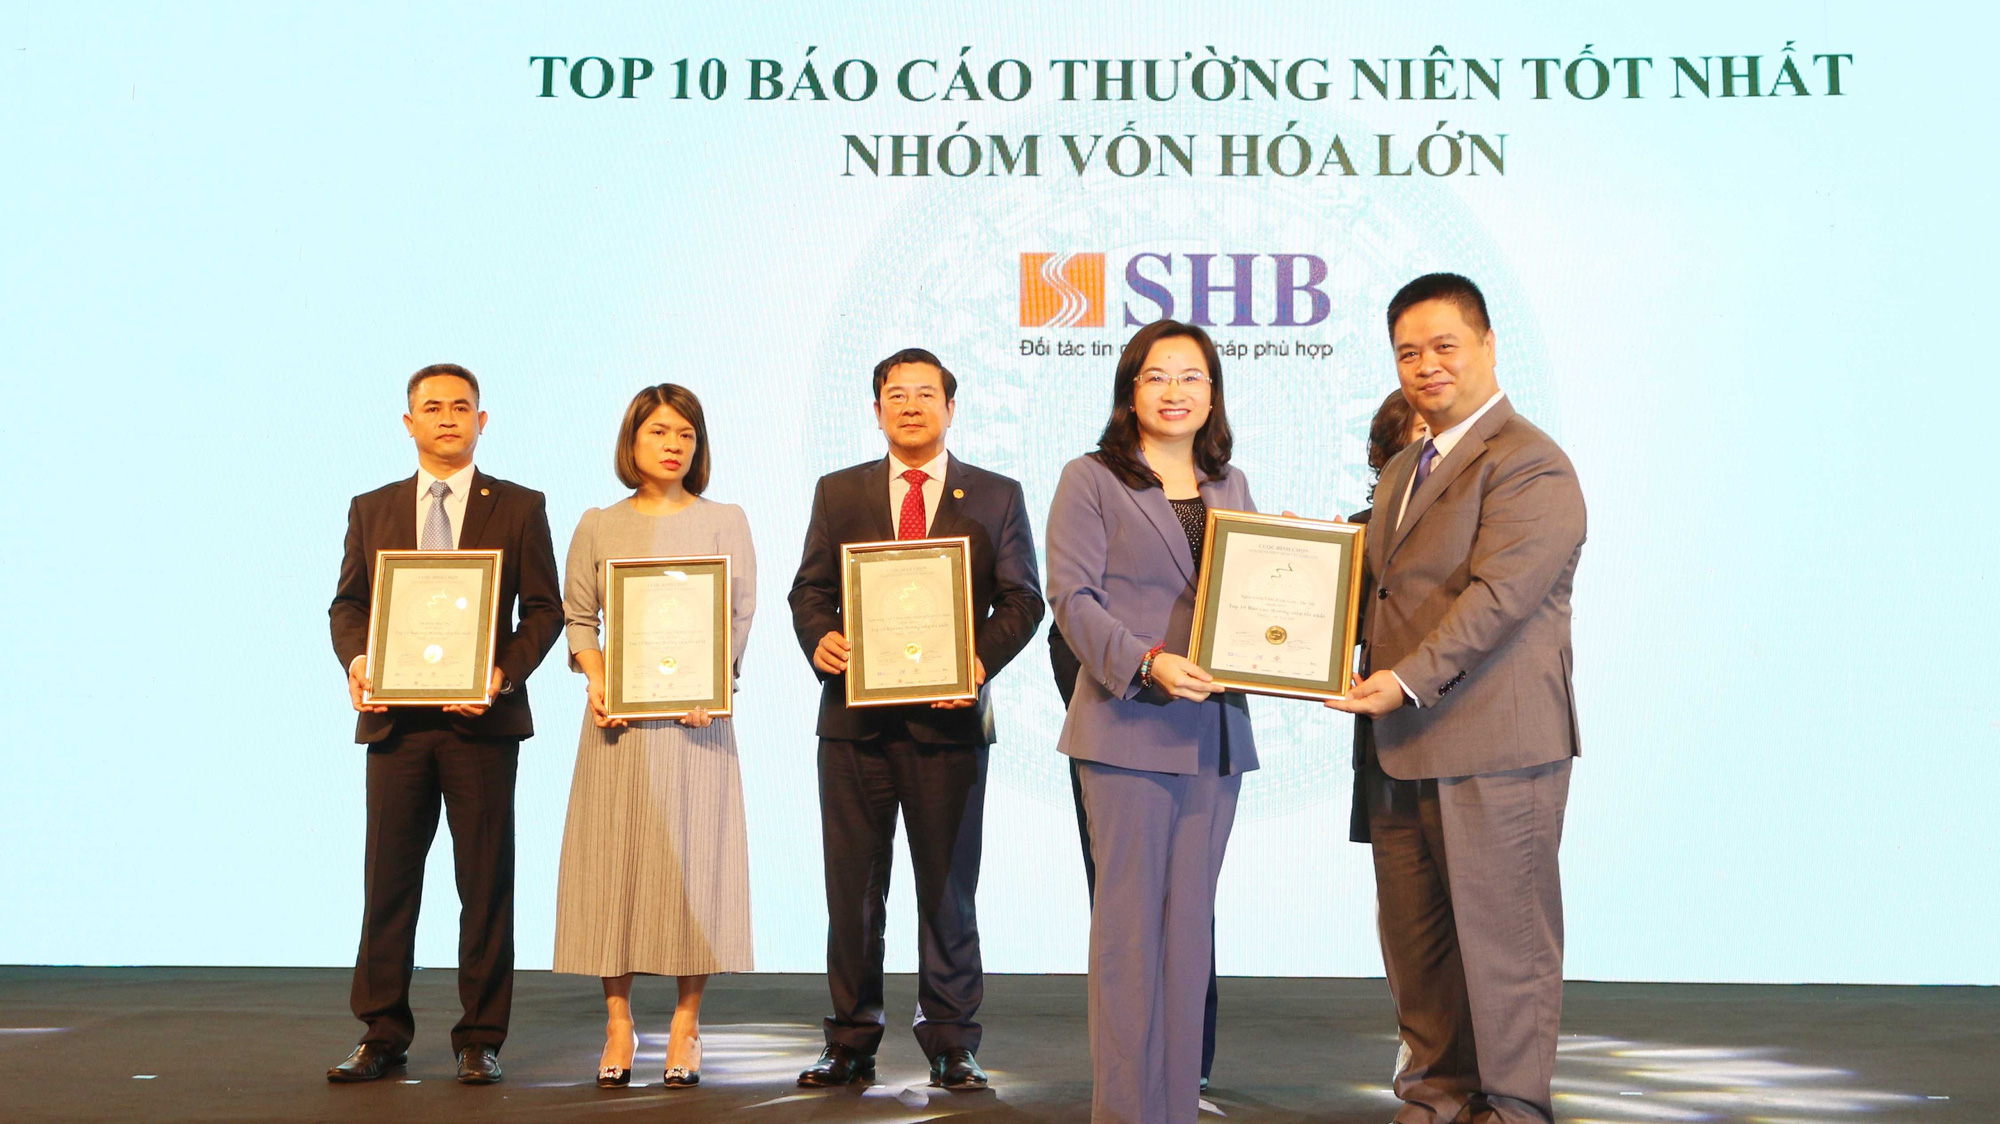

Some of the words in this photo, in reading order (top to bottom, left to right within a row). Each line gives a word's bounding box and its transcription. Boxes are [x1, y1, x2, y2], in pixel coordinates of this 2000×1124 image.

[530, 56, 655, 99] TOP
[671, 58, 727, 100] 10
[747, 45, 878, 102] BÁO
[897, 46, 1032, 102] CÁO
[1050, 46, 1331, 102] THƯỜNG
[1351, 44, 1503, 101] NIÊN
[1521, 43, 1653, 101] TỐT
[1669, 40, 1853, 99] NHẤT
[841, 120, 1040, 178] NHÓM
[1060, 120, 1196, 178] VỐN
[1220, 120, 1358, 177] HÓA
[1376, 120, 1506, 178] LỚN
[1124, 252, 1331, 327] SHB
[1020, 336, 1050, 357] Đối
[1058, 340, 1086, 357] tác
[1091, 340, 1112, 357] tin
[1212, 340, 1248, 360] háp
[1295, 340, 1334, 360] hợp
